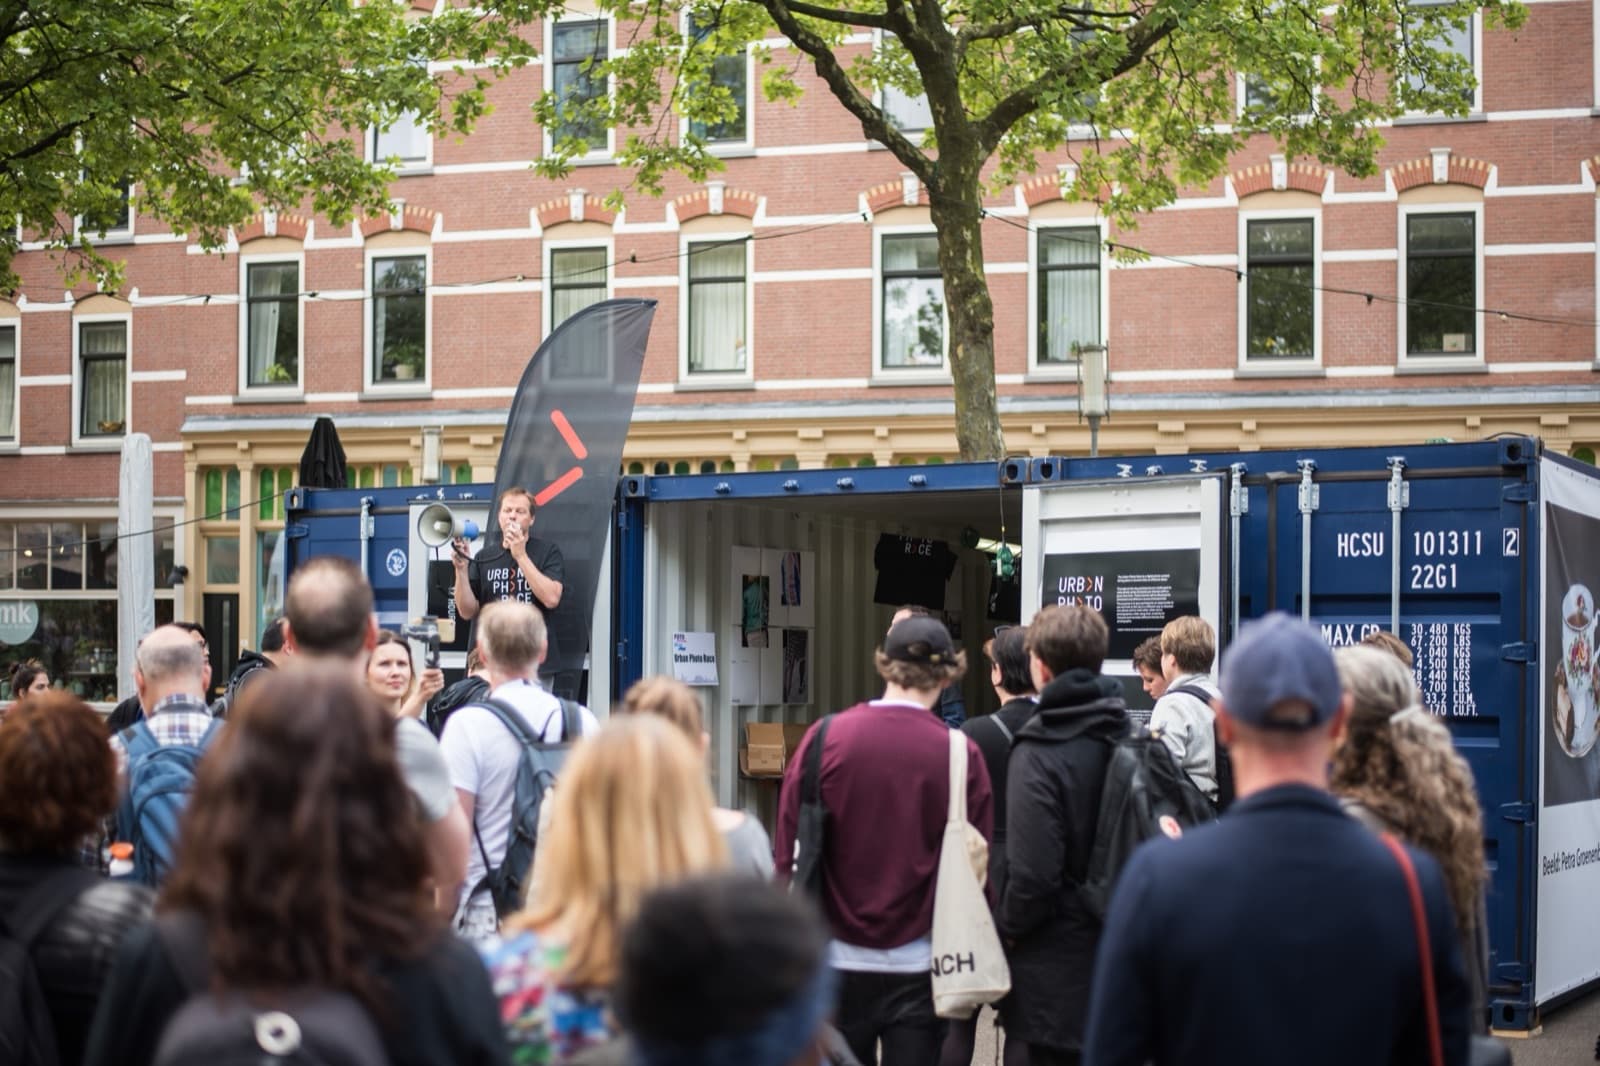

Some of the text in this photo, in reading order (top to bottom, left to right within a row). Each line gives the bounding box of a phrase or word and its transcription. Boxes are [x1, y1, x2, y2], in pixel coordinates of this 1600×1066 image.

[1337, 530, 1517, 557] HCSU 101311 2
[1411, 563, 1457, 589] 22G1
[1454, 623, 1471, 635] KGS
[1453, 635, 1471, 646] LBS
[1453, 647, 1471, 658] KGS
[674, 653, 715, 664] Urban Photo Race
[1453, 658, 1471, 669] LBS
[1453, 670, 1471, 681] KGS
[1453, 681, 1470, 692] LBS
[1561, 850, 1576, 871] Petra
